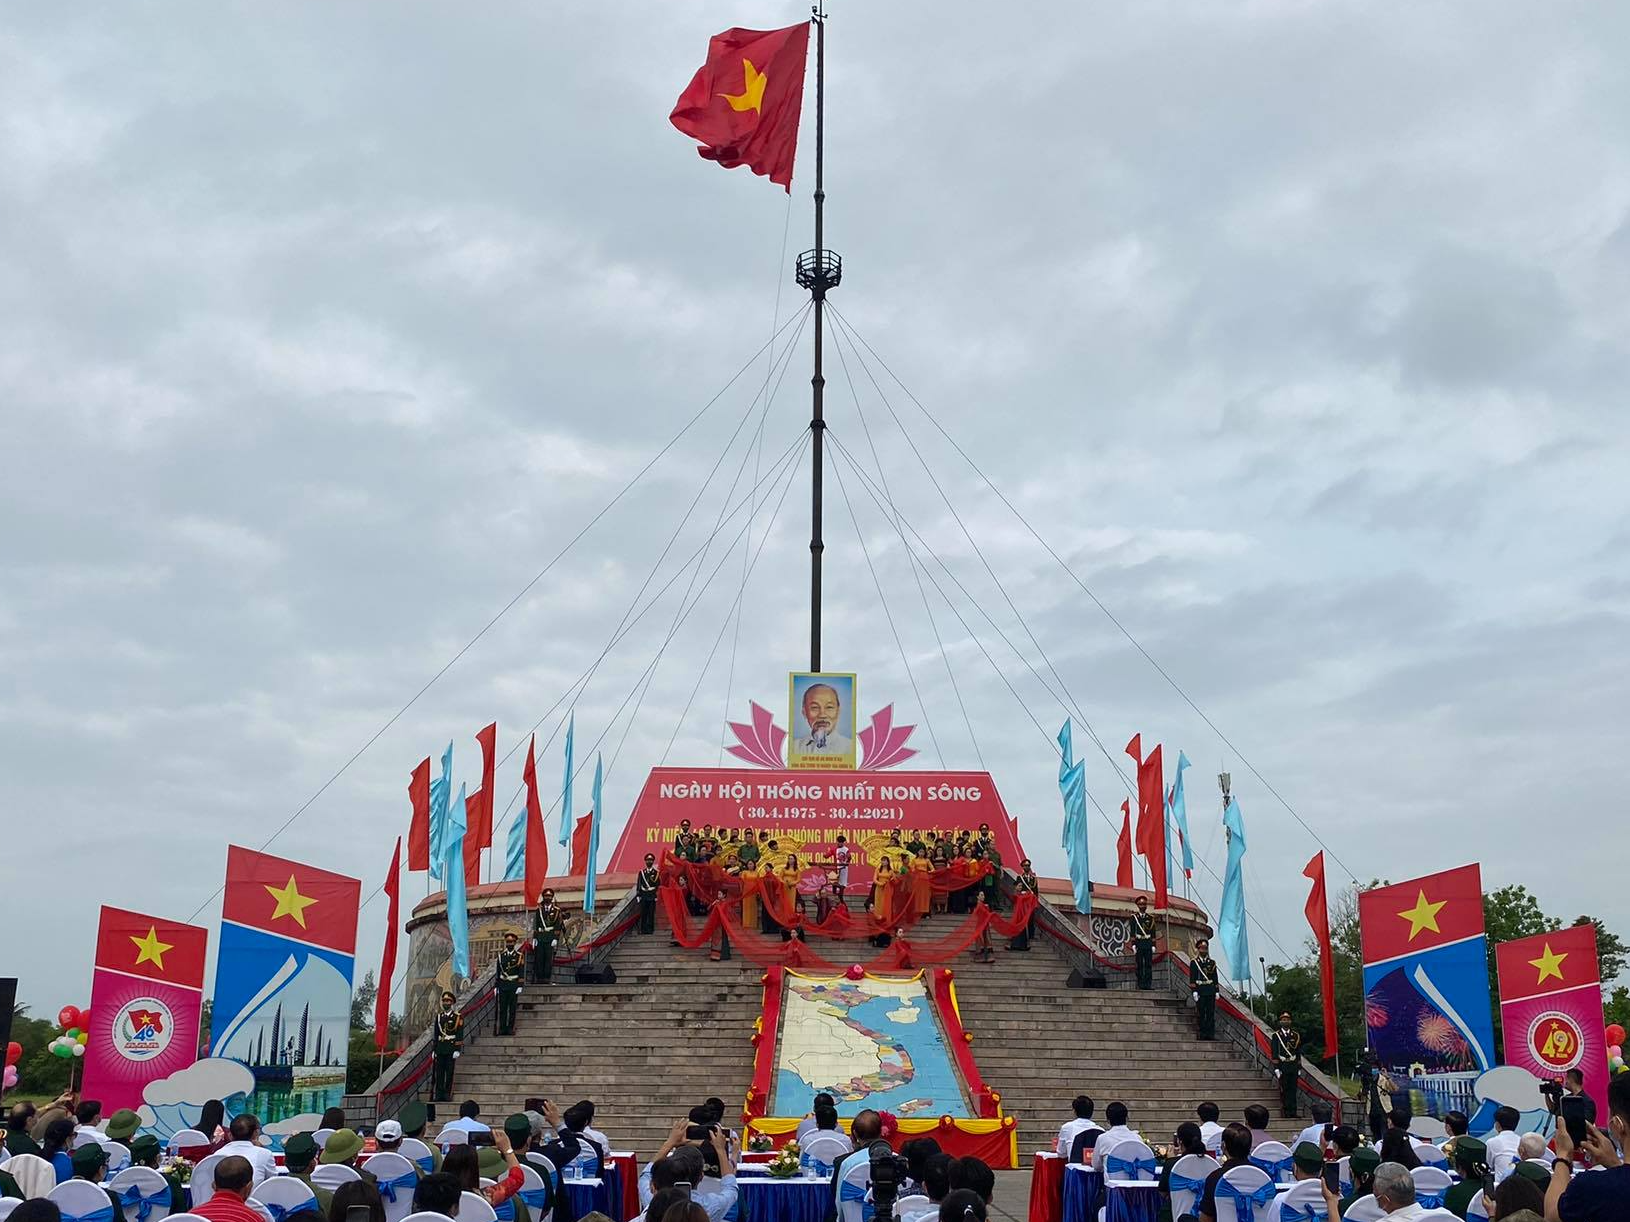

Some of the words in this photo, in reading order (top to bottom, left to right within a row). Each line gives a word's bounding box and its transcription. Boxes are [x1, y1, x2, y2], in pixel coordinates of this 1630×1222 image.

[660, 781, 712, 799] NGÀY
[719, 781, 751, 803] HỘI
[757, 780, 822, 800] THỐNG
[829, 781, 875, 800] NHẤT
[881, 786, 922, 801] NON
[928, 783, 981, 801] SÔNG
[787, 825, 821, 843] PHÓNG
